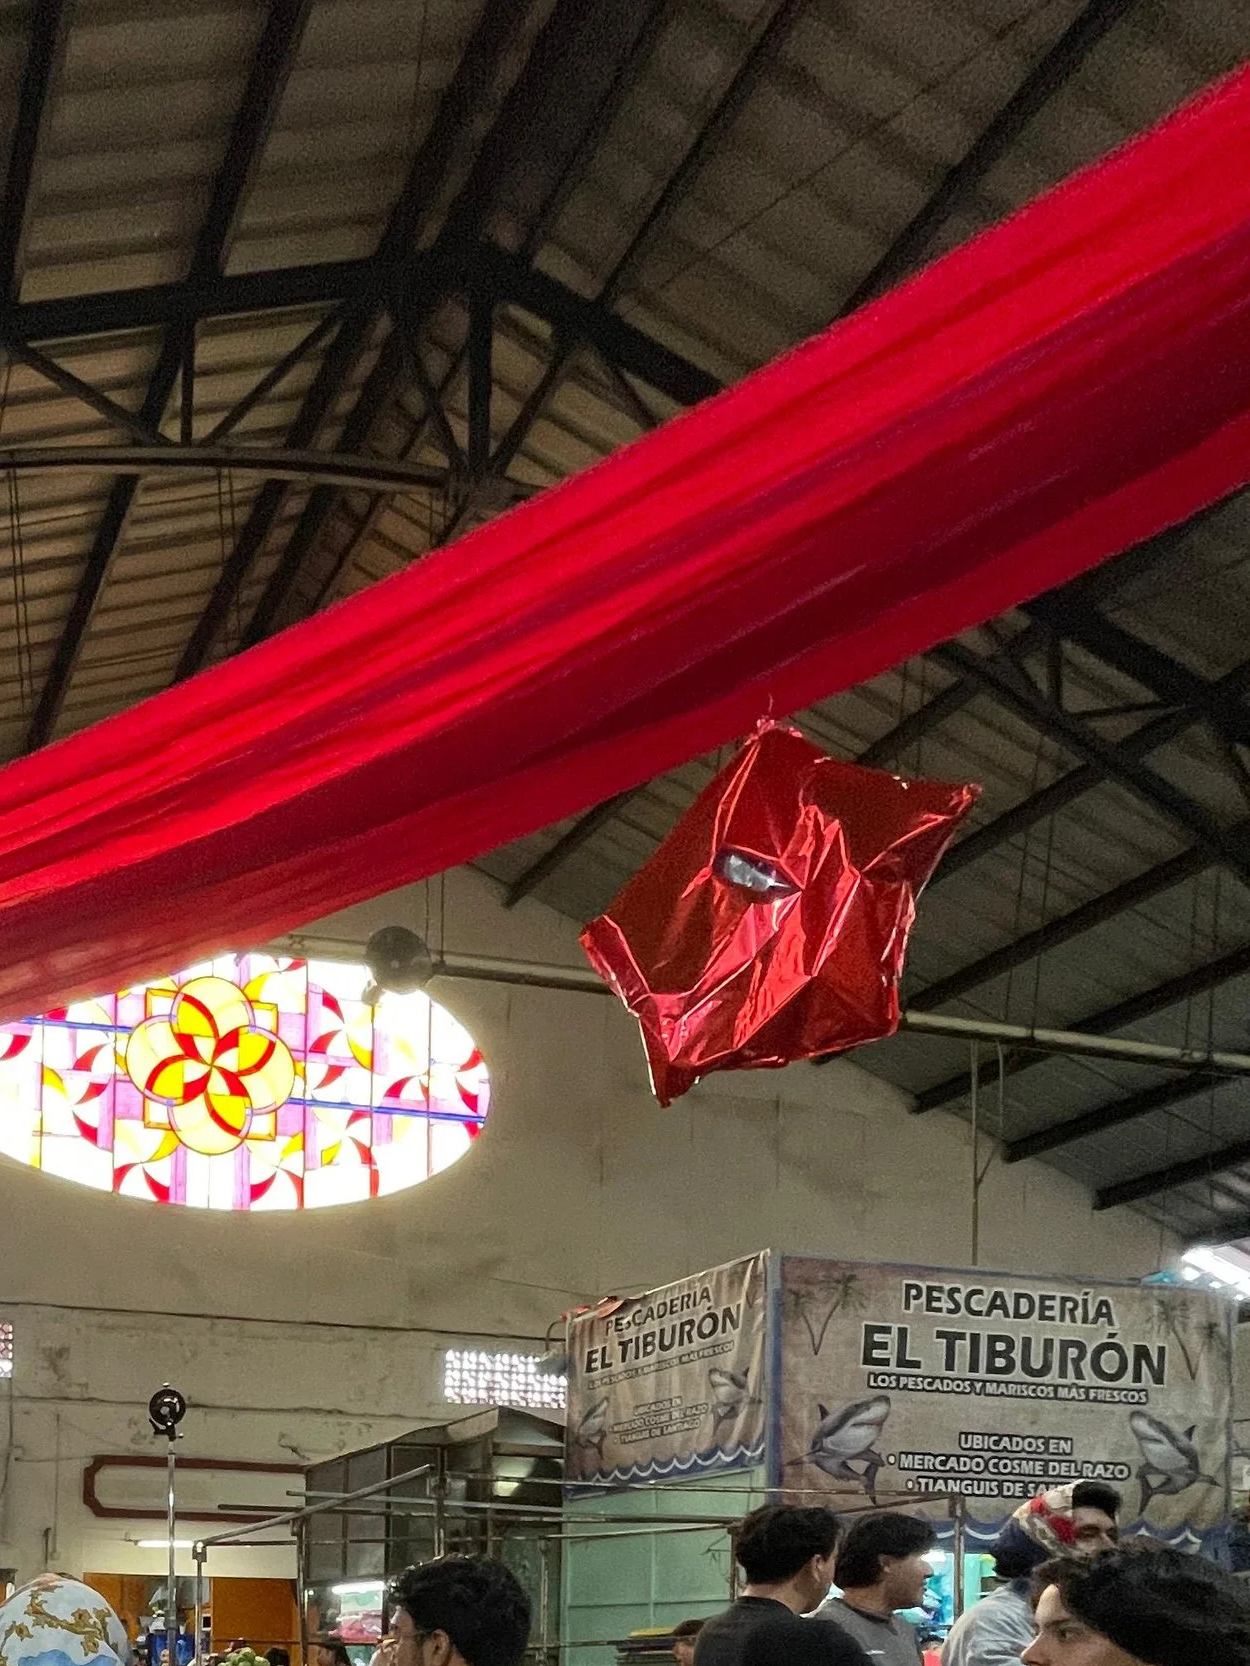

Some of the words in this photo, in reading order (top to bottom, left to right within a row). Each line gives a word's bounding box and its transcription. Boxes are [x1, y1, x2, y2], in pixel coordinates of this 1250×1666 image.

[903, 1282, 1115, 1326] PESCADERÍA
[584, 1345, 613, 1374] EL
[618, 1303, 742, 1364] TIBURÓN
[861, 1323, 922, 1369] EL
[935, 1330, 1166, 1386] TIBURÓN
[869, 1373, 897, 1389] LOS
[898, 1377, 971, 1394] PESCADOS
[973, 1381, 984, 1395] Y
[985, 1382, 1054, 1399] MARISCOS
[1088, 1389, 1148, 1404] FRESCOS
[960, 1433, 1045, 1452] UBICADOS
[1049, 1437, 1071, 1453] EN
[900, 1454, 985, 1472] MERCADO
[988, 1458, 1044, 1475] COSME
[1048, 1461, 1081, 1476] DEL
[1082, 1463, 1130, 1479] RAZO
[917, 1478, 999, 1496] TIANGUIS
[1002, 1482, 1023, 1497] DE
